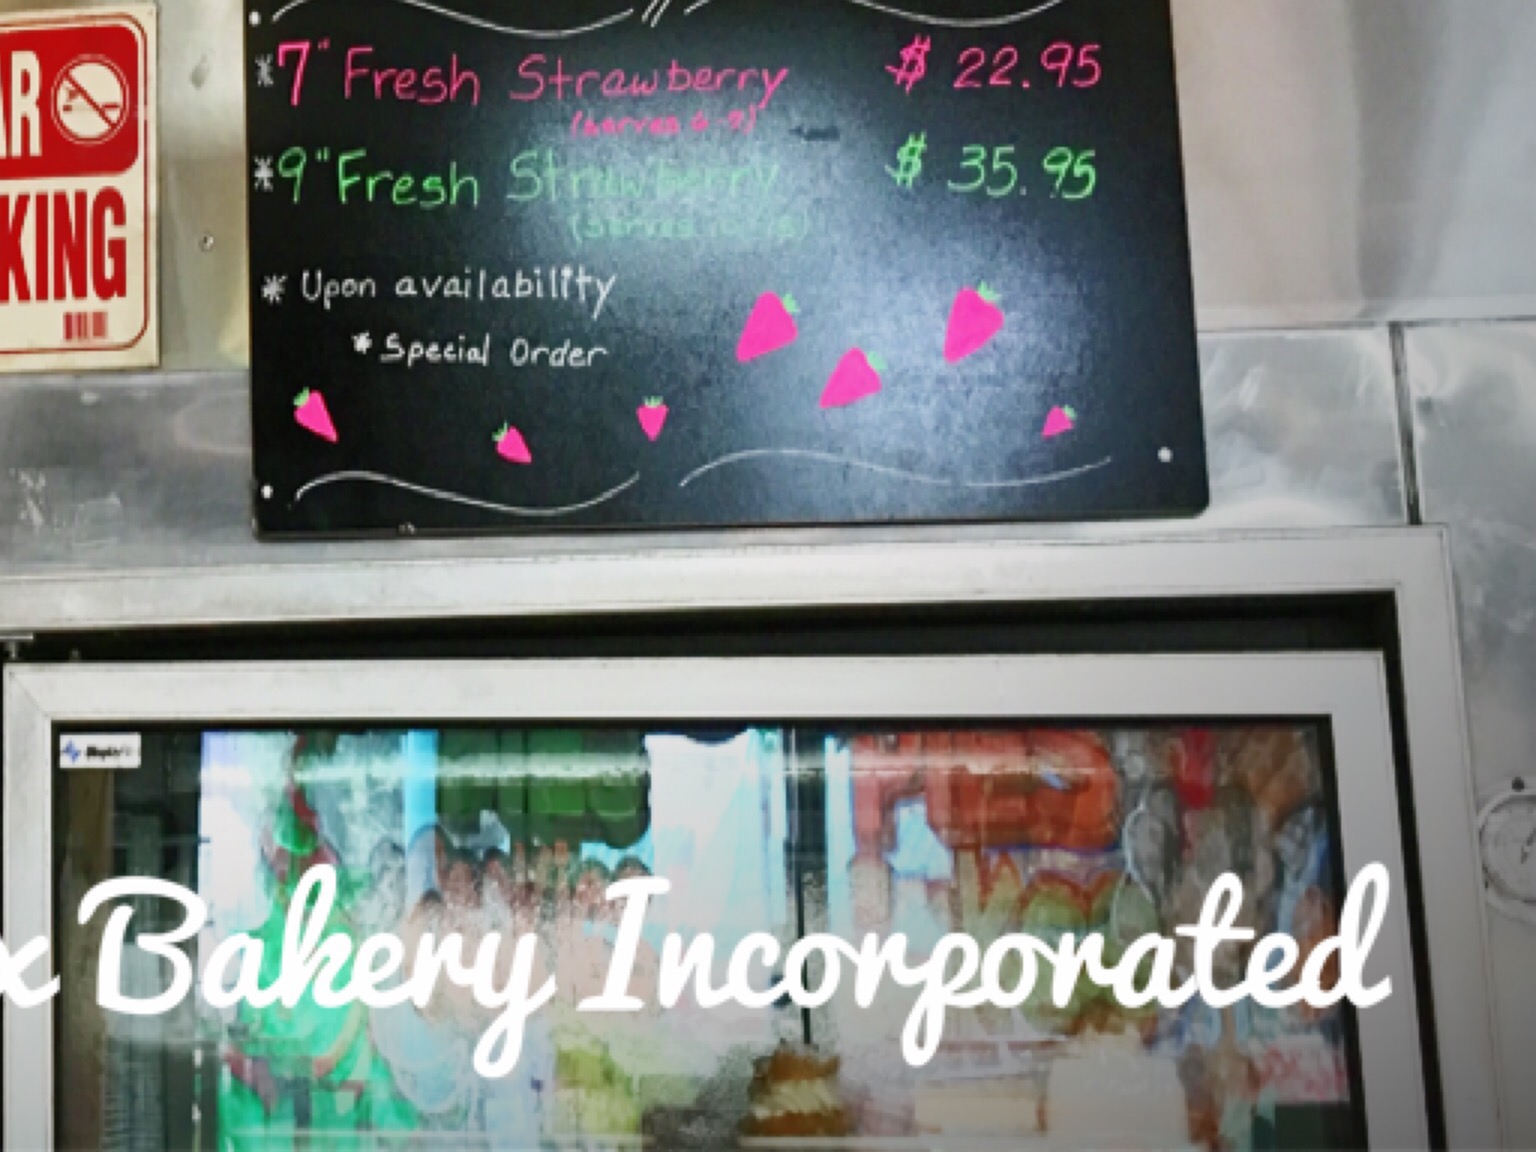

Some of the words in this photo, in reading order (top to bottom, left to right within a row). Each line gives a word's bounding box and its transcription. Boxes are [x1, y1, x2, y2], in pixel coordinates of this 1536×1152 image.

[344, 45, 481, 106] Fresh
[508, 52, 790, 110] Strawberry
[953, 41, 1102, 91] 22.95
[338, 148, 481, 209] Fresh
[506, 147, 782, 204] Strawberry
[947, 145, 1098, 201] 35.95
[301, 268, 377, 311] Upon
[394, 263, 617, 322] availability
[380, 331, 490, 369] Special
[509, 335, 610, 368] Order
